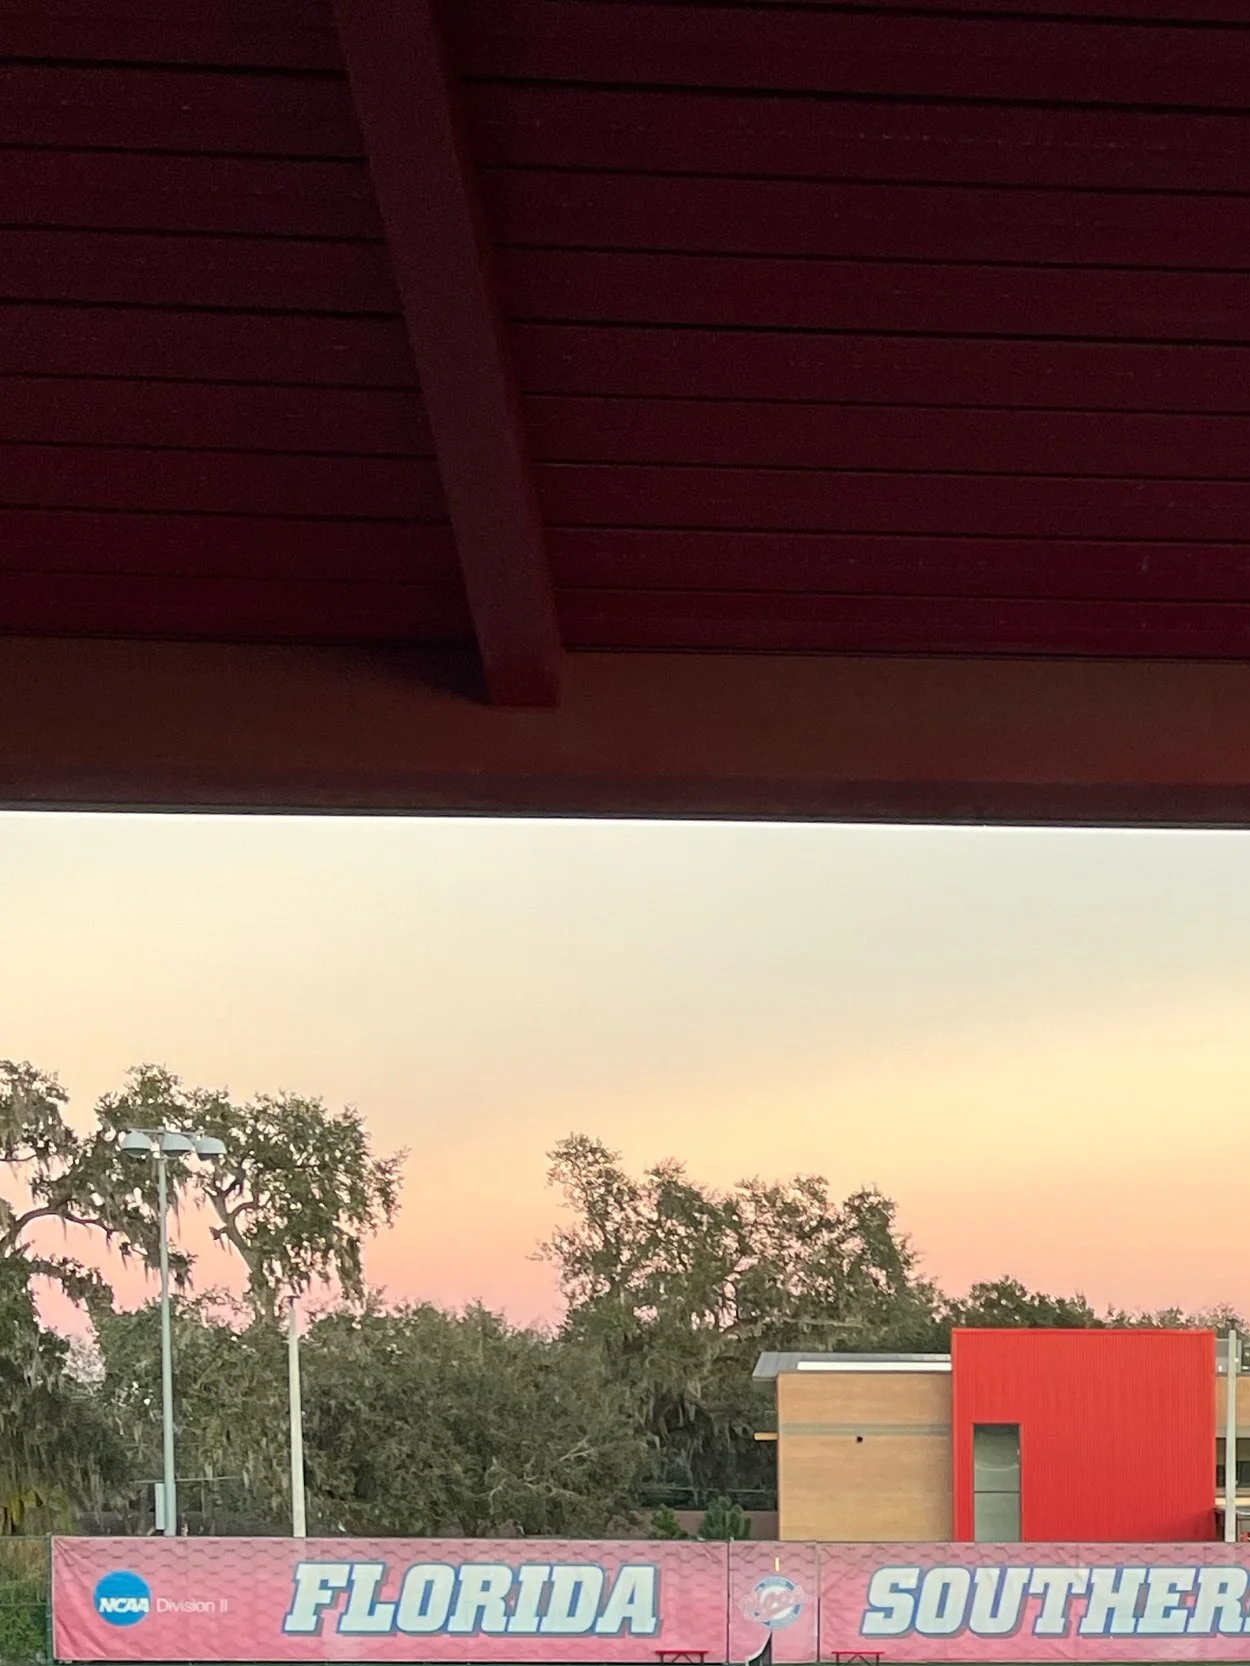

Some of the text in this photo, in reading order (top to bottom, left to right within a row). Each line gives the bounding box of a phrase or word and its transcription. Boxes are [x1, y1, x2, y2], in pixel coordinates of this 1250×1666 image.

[99, 1597, 229, 1613] NCAA Division II
[283, 1561, 661, 1637] FLORIDA
